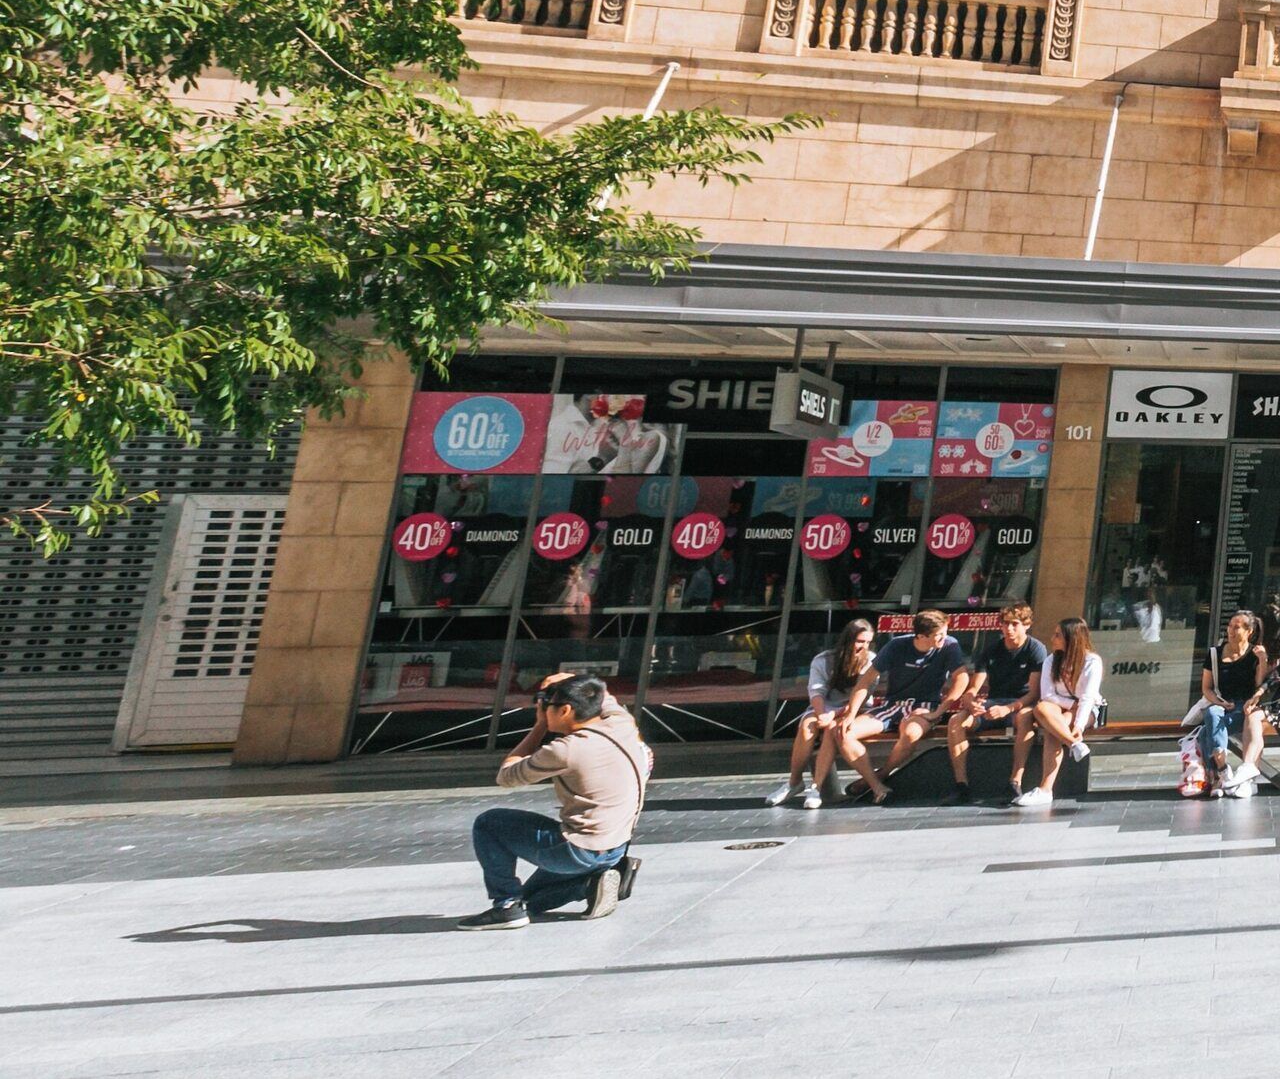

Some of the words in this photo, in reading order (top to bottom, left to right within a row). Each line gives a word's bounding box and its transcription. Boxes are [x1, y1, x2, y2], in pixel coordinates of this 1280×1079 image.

[800, 388, 826, 419] SHIELS
[1115, 411, 1225, 424] OAKLEY
[866, 424, 882, 439] 1/2
[1065, 425, 1093, 441] 101
[487, 432, 511, 449] OFF
[466, 528, 519, 543] DIAMONDS
[612, 528, 654, 546] GOLD
[705, 536, 718, 545] OFF
[744, 528, 794, 540] DIAMONDS
[873, 528, 916, 544] SILVER
[957, 536, 969, 545] OFF
[998, 528, 1033, 545] GOLD
[430, 536, 443, 547] OFF
[568, 536, 582, 546] OFF
[832, 537, 844, 546] OFF
[890, 617, 907, 629] 25%
[968, 616, 984, 626] 25%
[984, 616, 999, 626] OFF
[407, 654, 434, 665] JAG
[1112, 661, 1161, 675] SHADES
